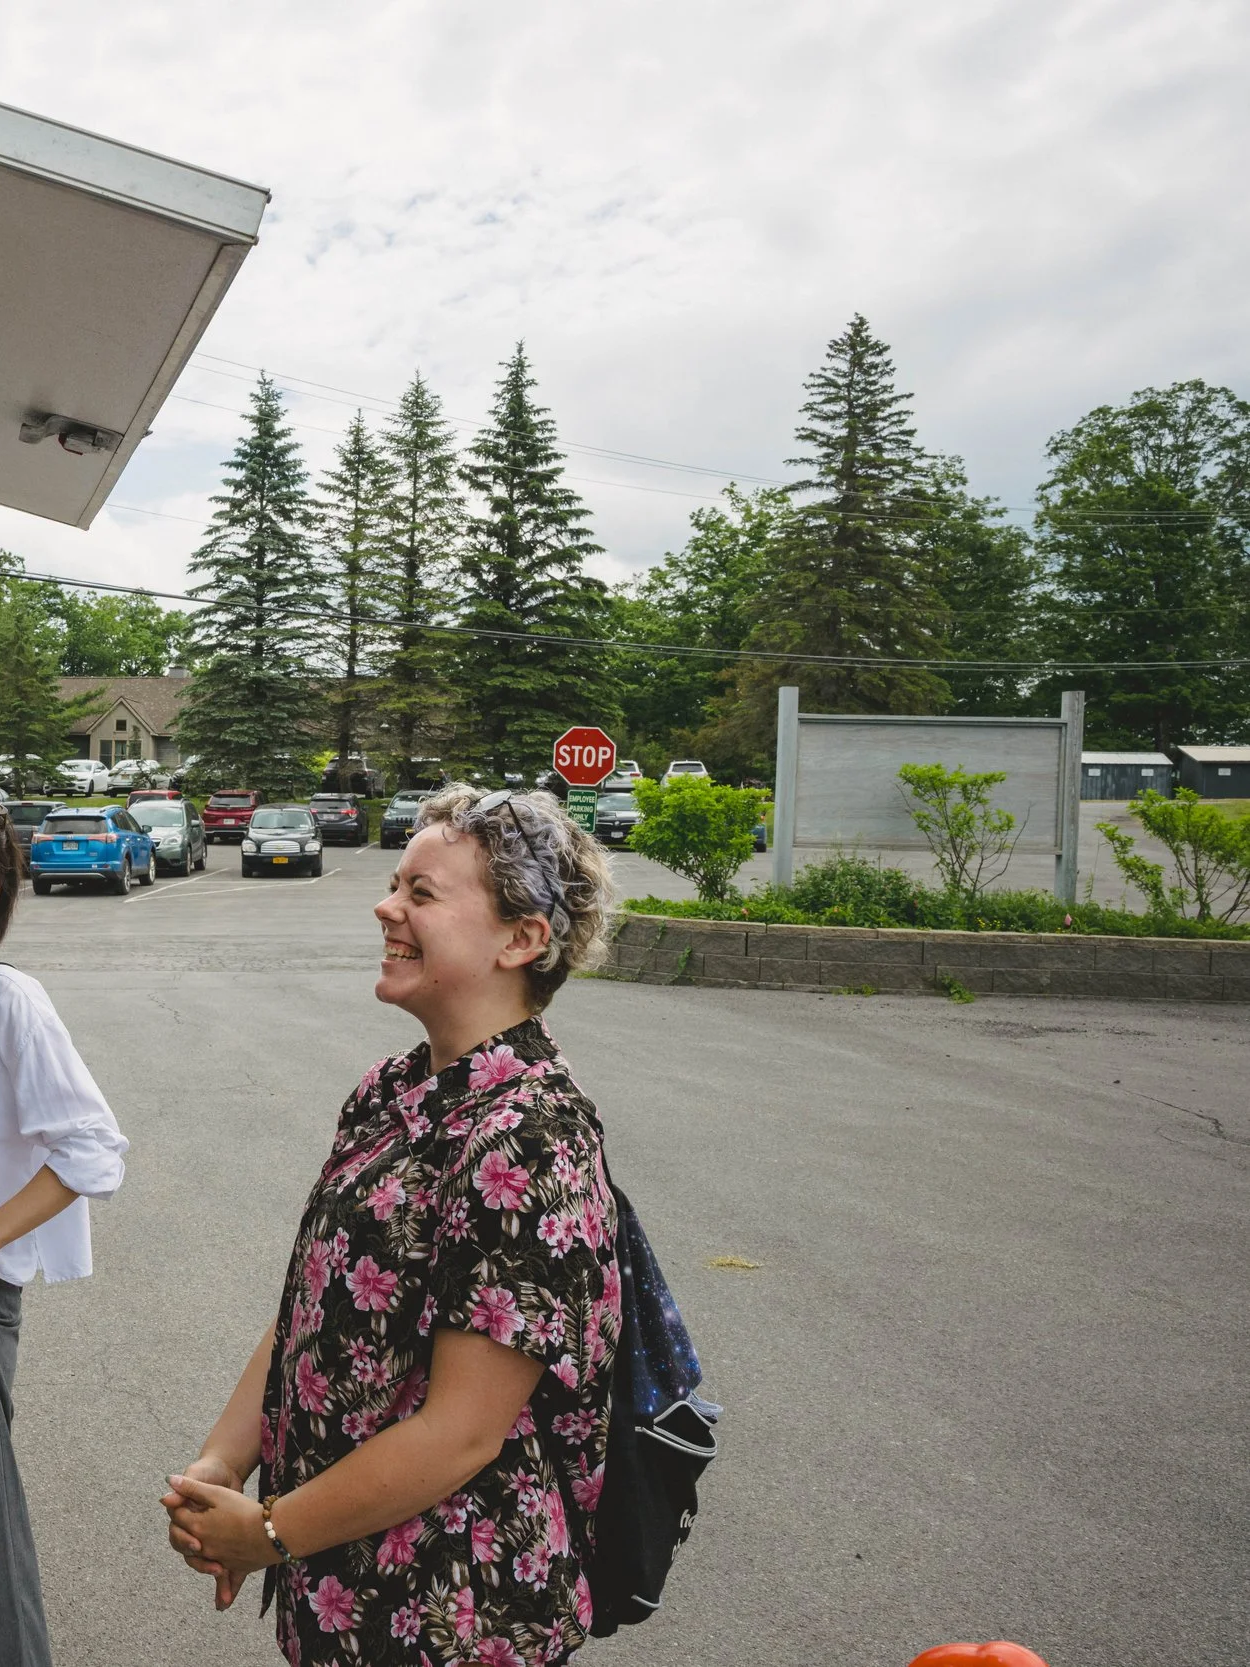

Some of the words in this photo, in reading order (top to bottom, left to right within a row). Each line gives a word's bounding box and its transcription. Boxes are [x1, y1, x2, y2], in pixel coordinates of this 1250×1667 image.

[558, 745, 611, 767] STOP
[569, 795, 595, 803] EMPLOYEE
[570, 805, 593, 813] PARKING
